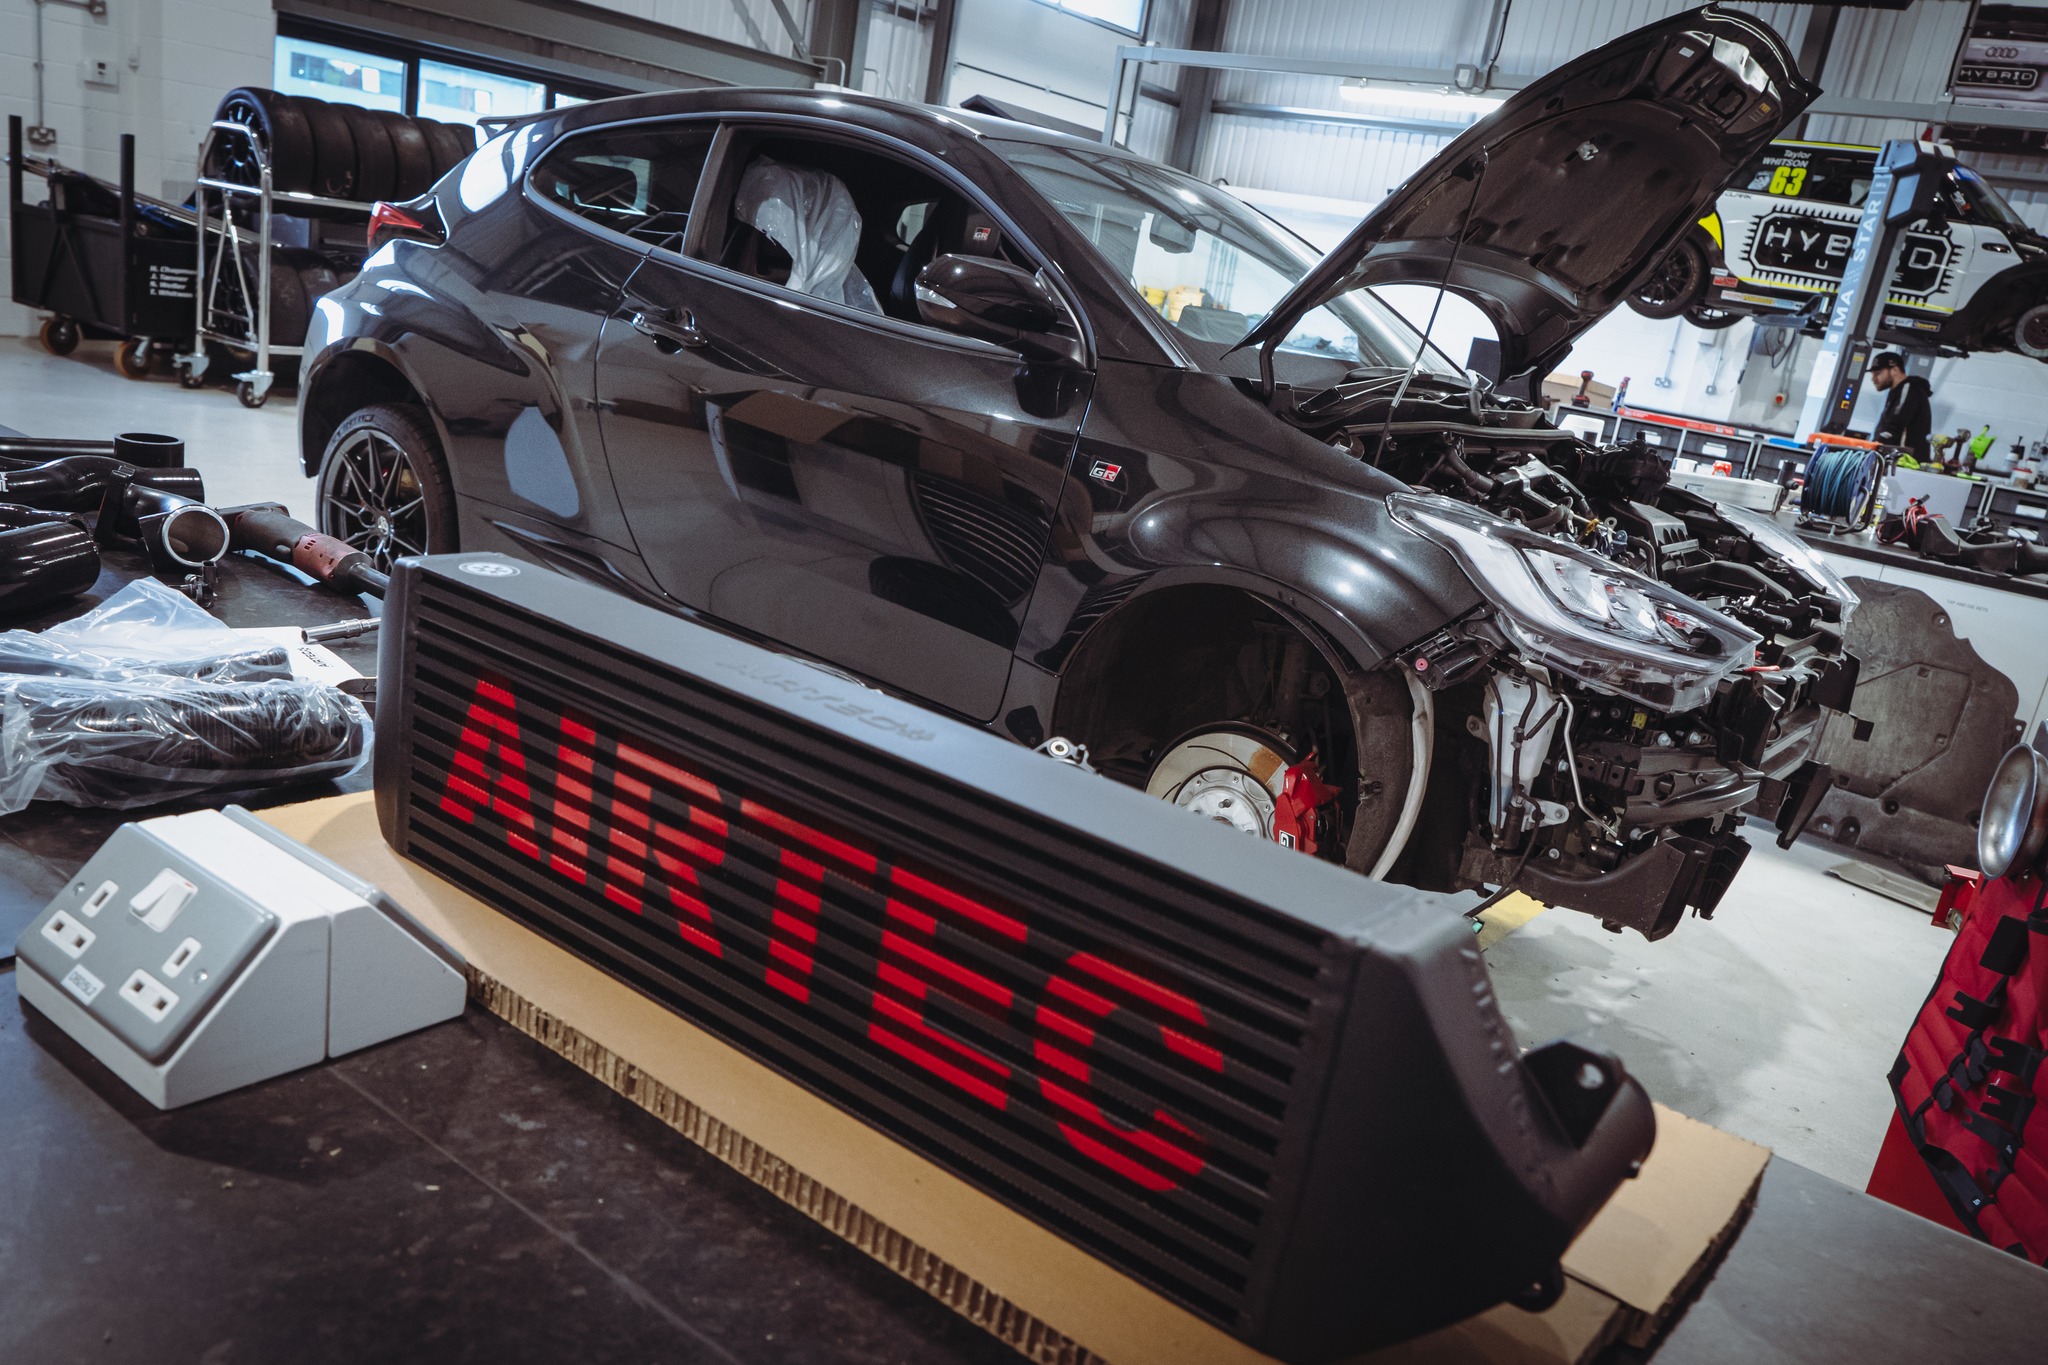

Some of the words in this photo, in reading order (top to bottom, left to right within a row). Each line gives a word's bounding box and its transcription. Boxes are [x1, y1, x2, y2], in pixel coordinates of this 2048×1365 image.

[1960, 69, 2033, 81] HYBRID
[1762, 156, 1809, 168] WHITSON
[1783, 149, 1811, 159] Taylor
[1768, 166, 1807, 196] 63
[1853, 199, 1882, 263] STAR
[1764, 225, 1937, 270] HYBD
[1092, 467, 1116, 480] GR
[437, 676, 1226, 1193] AIRTEC
